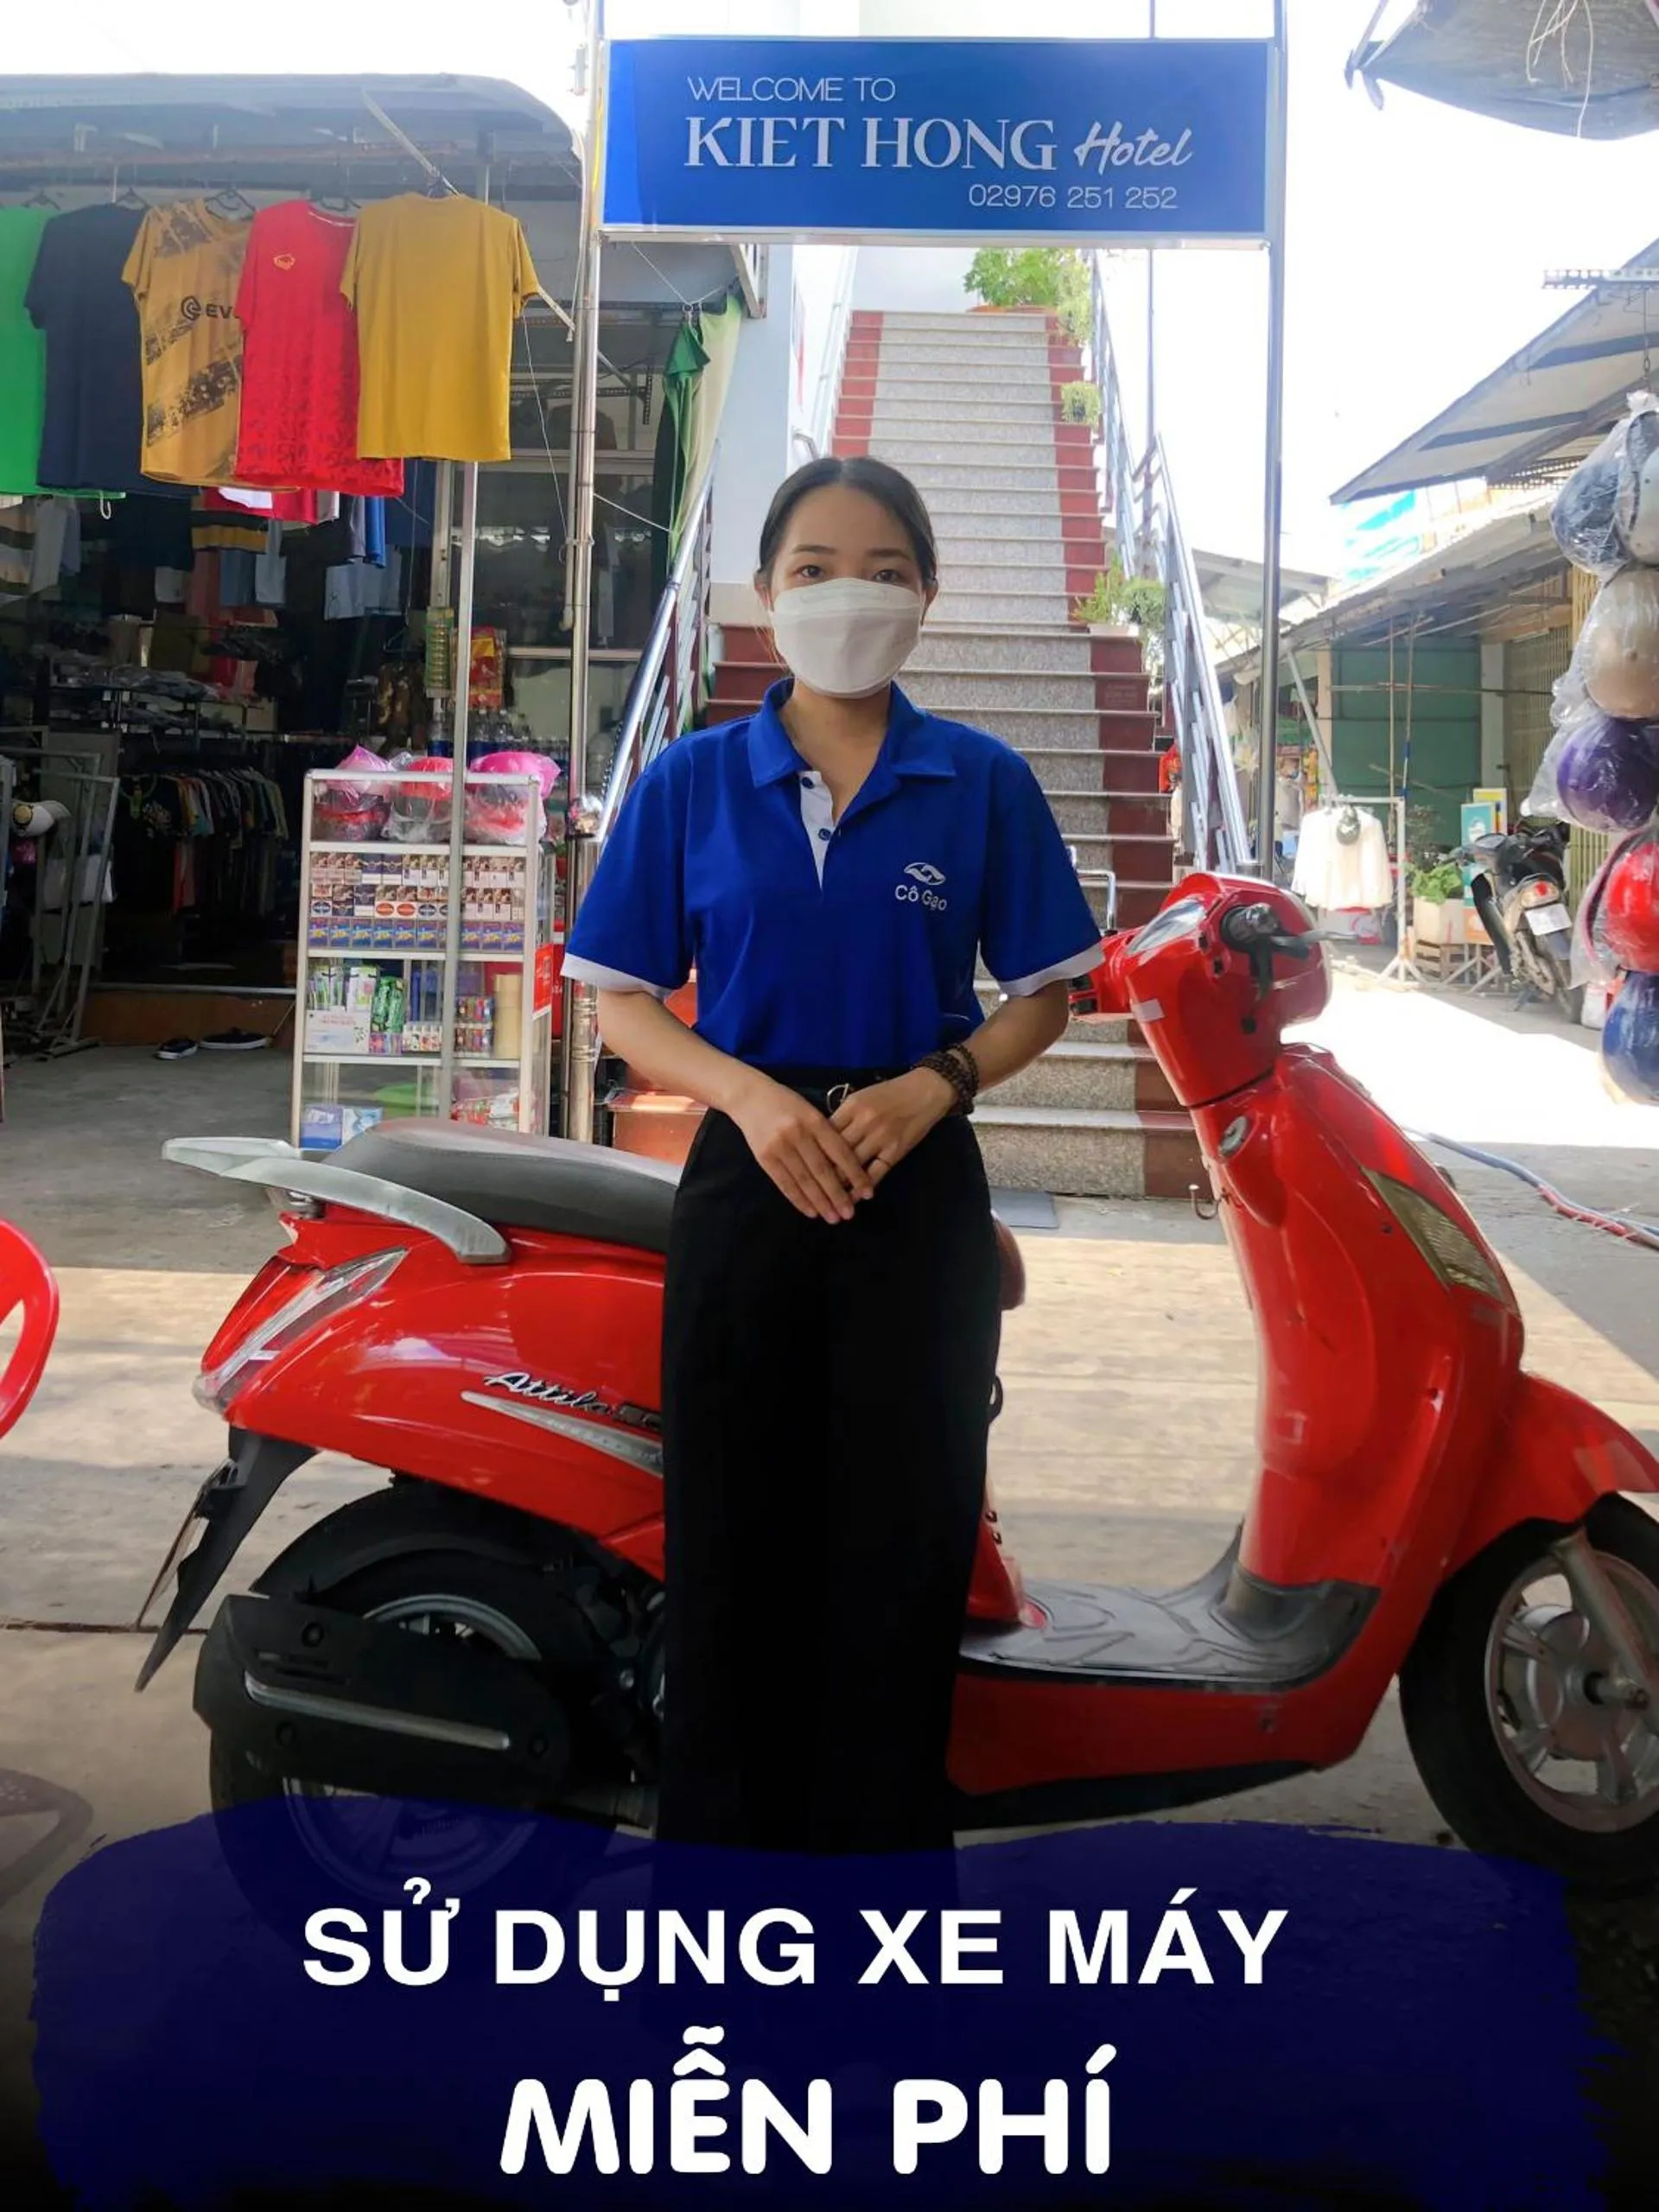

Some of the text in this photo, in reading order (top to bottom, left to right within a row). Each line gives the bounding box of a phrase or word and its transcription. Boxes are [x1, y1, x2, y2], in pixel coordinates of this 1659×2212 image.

[687, 76, 896, 102] WELCOME TO
[683, 117, 1194, 175] KIET HONG Hotel
[969, 184, 1179, 210] 02976 251 252
[894, 884, 919, 902] Cô
